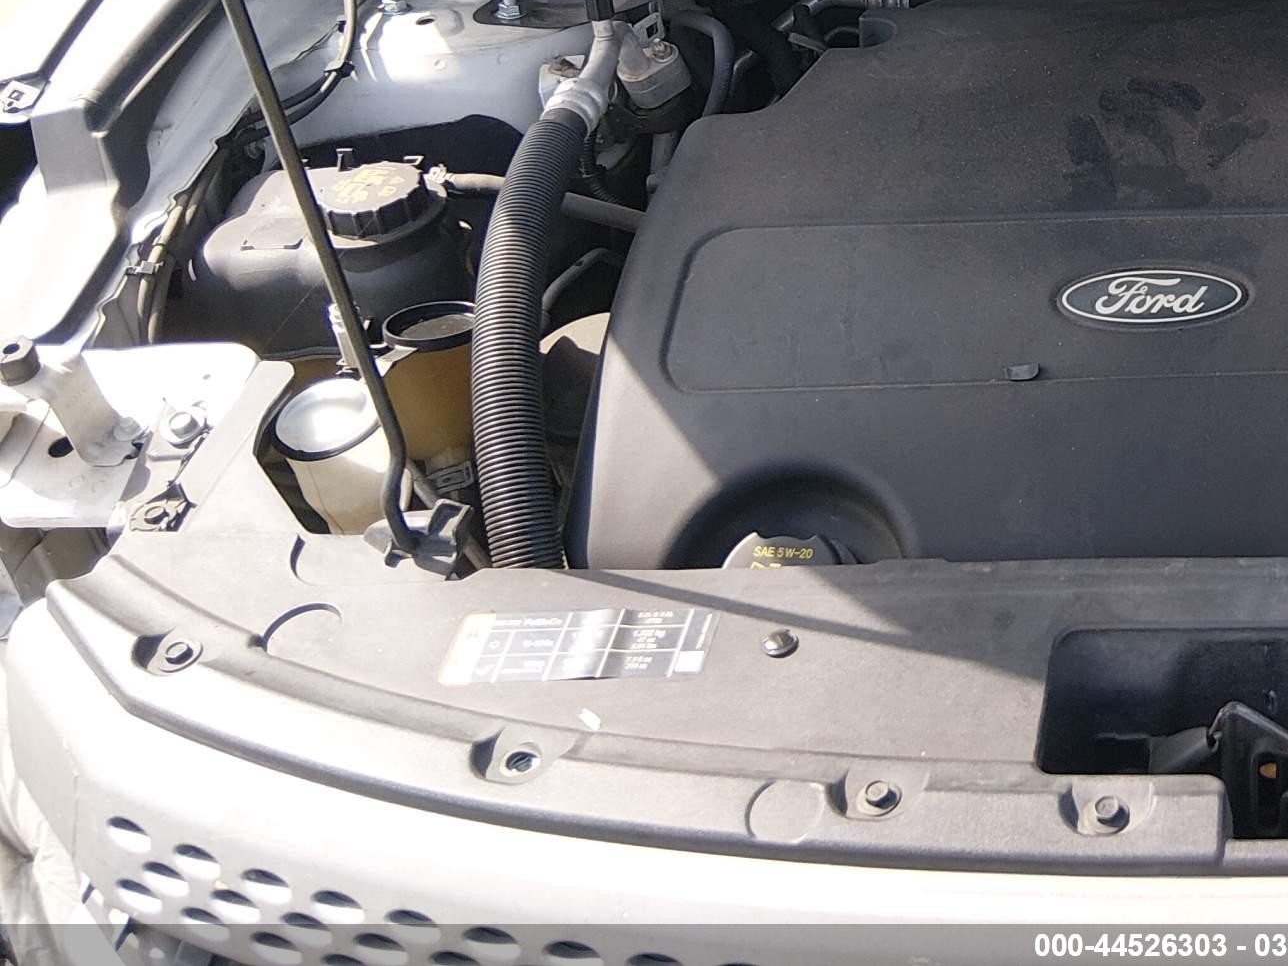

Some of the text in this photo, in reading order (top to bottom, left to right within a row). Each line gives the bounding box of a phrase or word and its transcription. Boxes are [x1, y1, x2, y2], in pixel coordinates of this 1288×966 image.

[1095, 277, 1208, 315] Ford
[753, 545, 814, 559] SAE 5W-20
